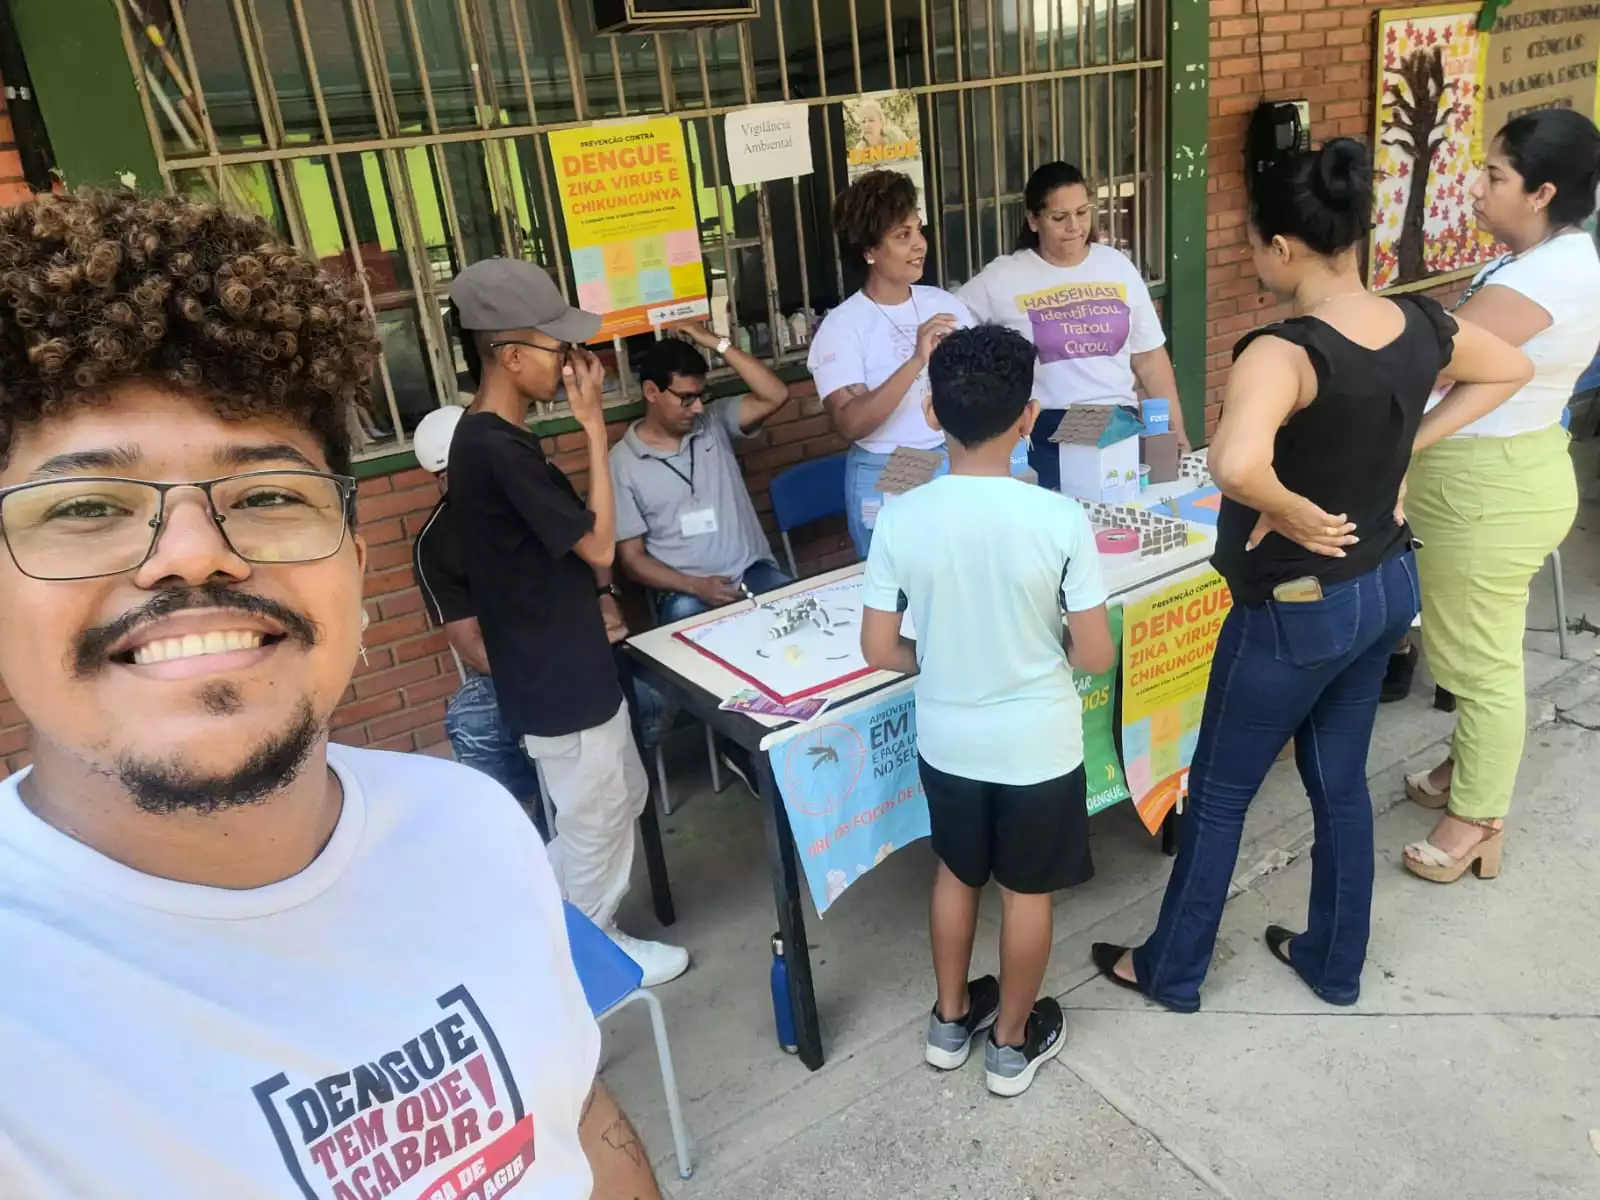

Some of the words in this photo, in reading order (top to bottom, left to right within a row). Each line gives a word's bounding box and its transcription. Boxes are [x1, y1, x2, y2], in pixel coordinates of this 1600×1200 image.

[580, 136, 624, 148] PREVENÇÃO
[625, 132, 655, 142] CONTRA
[741, 119, 791, 137] Vigilância
[743, 135, 793, 154] Ambiental
[567, 179, 607, 197] ZIKA
[668, 167, 680, 181] E
[571, 187, 682, 216] CHIKUNGUNYA
[1151, 588, 1194, 610] PREVENÇÃO
[1195, 577, 1222, 593] CONTRA
[1130, 586, 1232, 648] DENGUE
[1129, 640, 1168, 669] ZIKA
[870, 711, 908, 750] EM
[880, 739, 906, 760] FAÇA
[873, 760, 894, 780] NO
[1087, 783, 1124, 810] DENGUE
[285, 1013, 479, 1146] DENGUE
[309, 1107, 388, 1180] TEM
[457, 1156, 487, 1191] DE
[483, 1154, 525, 1200] AGIR
